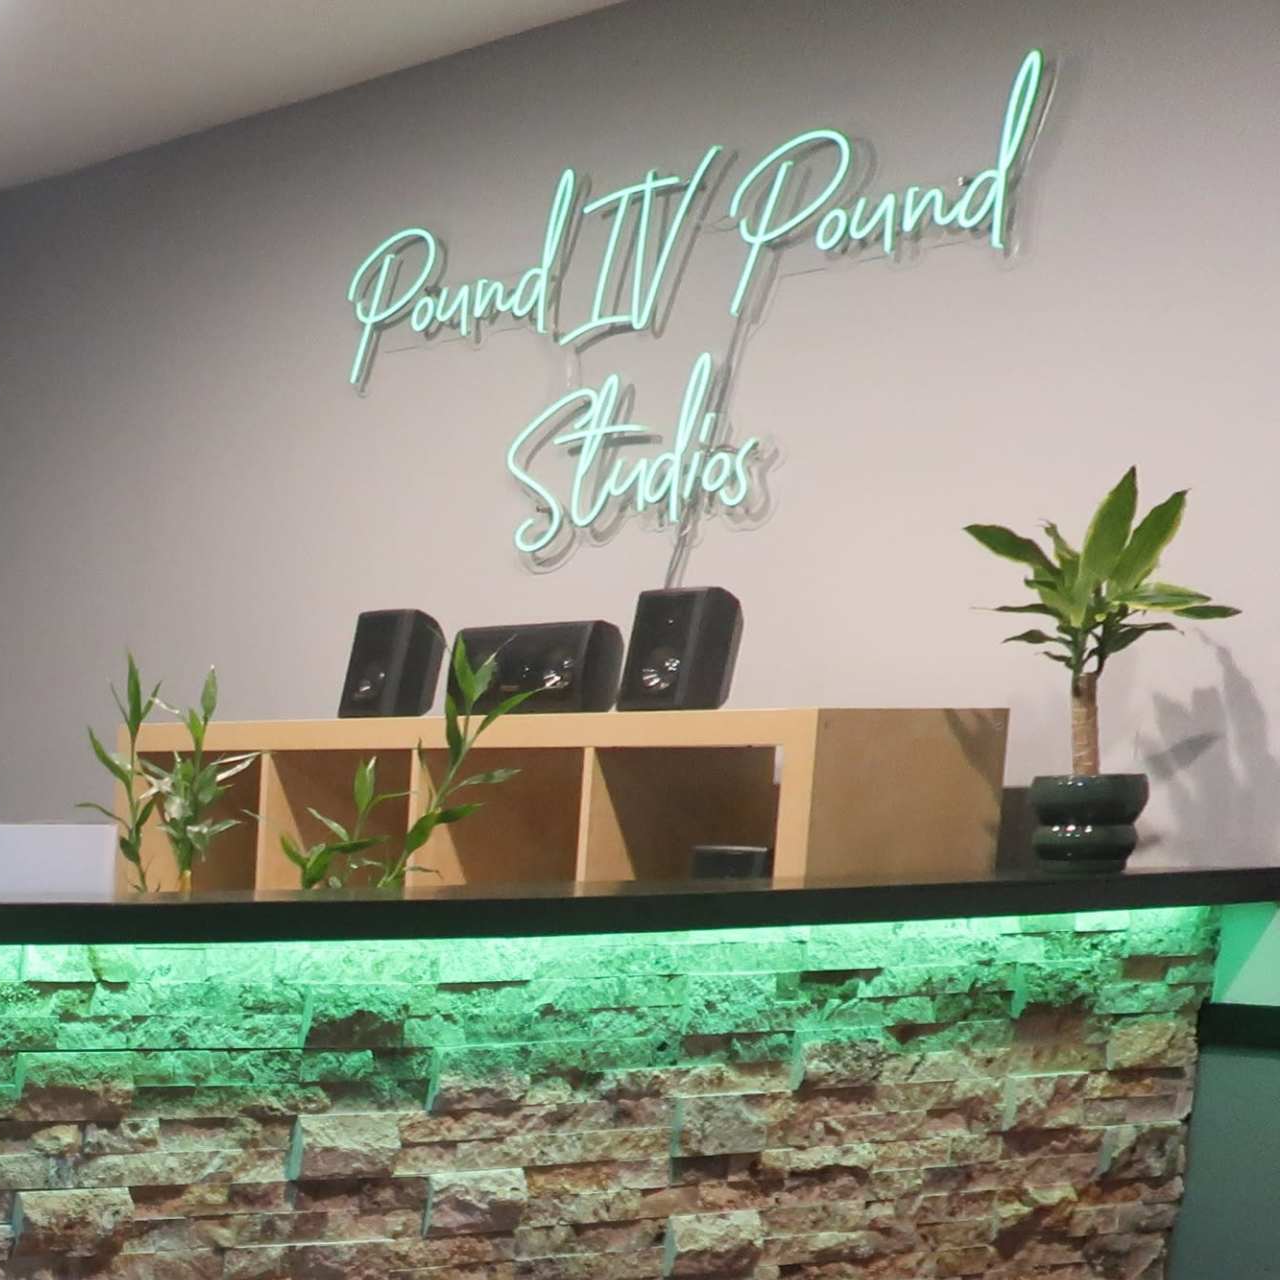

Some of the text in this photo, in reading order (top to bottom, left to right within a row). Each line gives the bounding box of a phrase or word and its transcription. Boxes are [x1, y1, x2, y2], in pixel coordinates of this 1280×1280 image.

[347, 48, 1043, 385] Pound IV Pound
[506, 351, 763, 554] Studios
